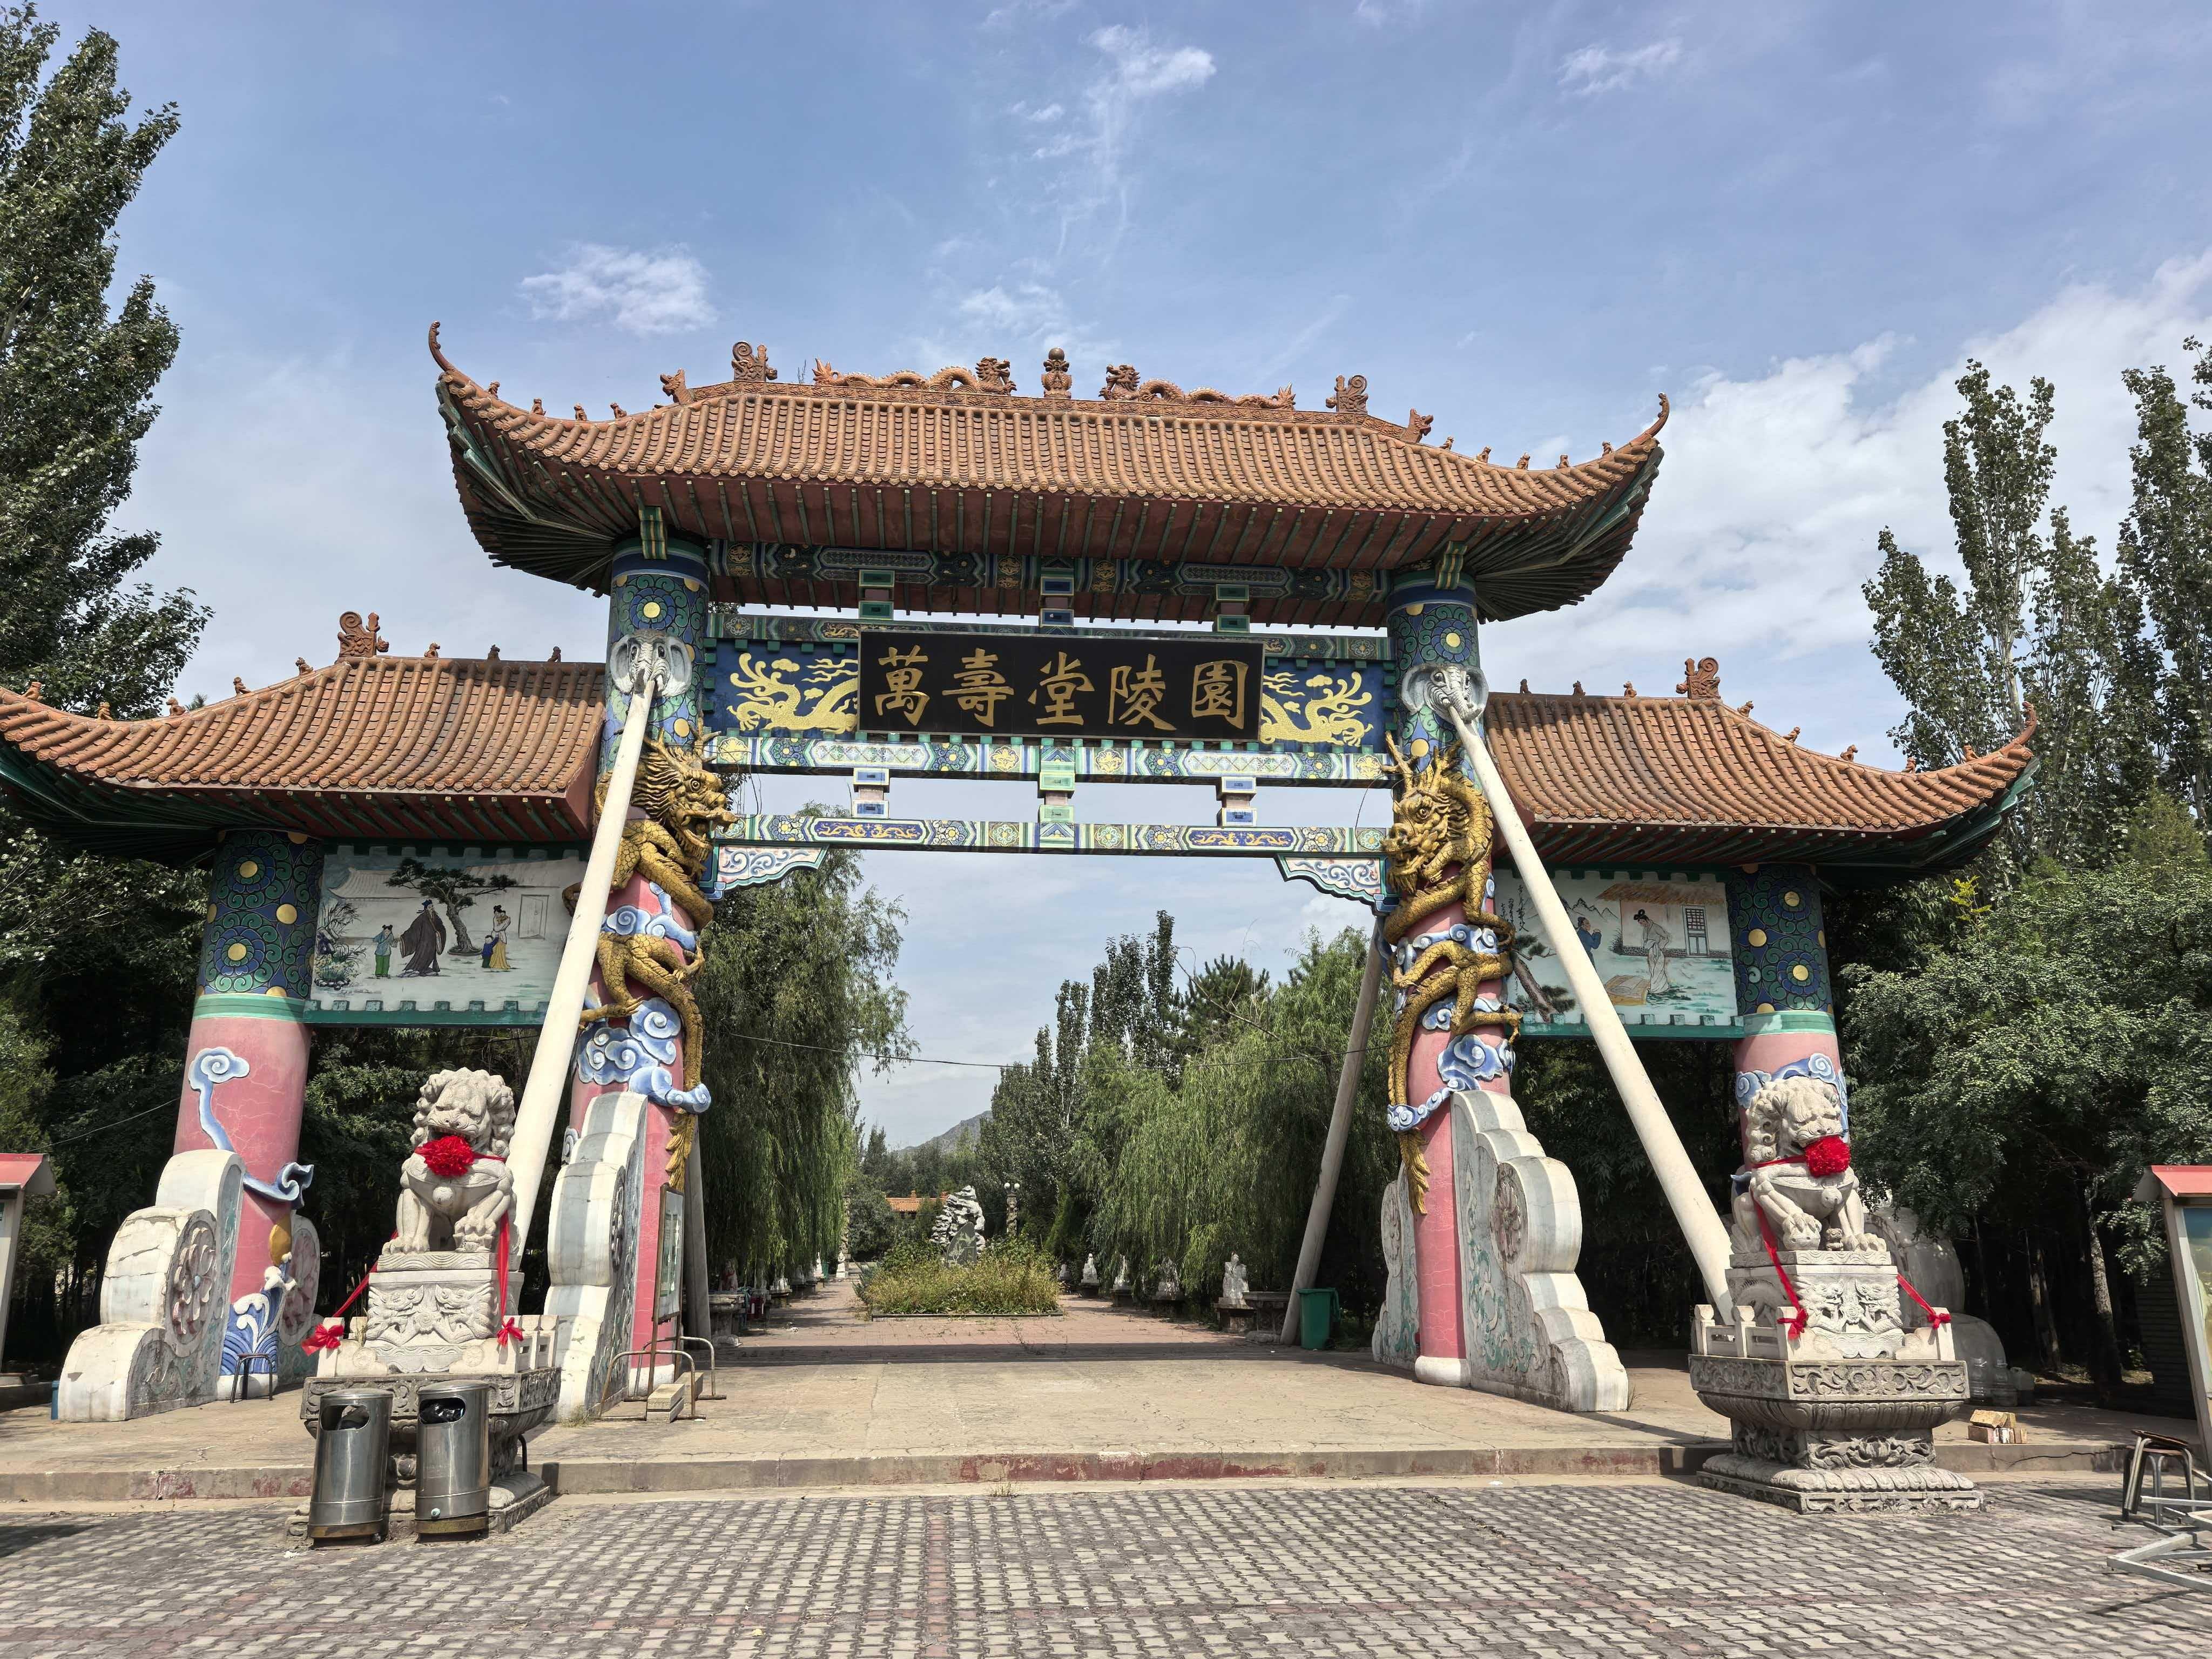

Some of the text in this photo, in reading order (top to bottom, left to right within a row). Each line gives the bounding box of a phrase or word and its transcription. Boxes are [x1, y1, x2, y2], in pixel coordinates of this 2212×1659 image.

[874, 644, 1250, 731] 萬壽堂陵園
